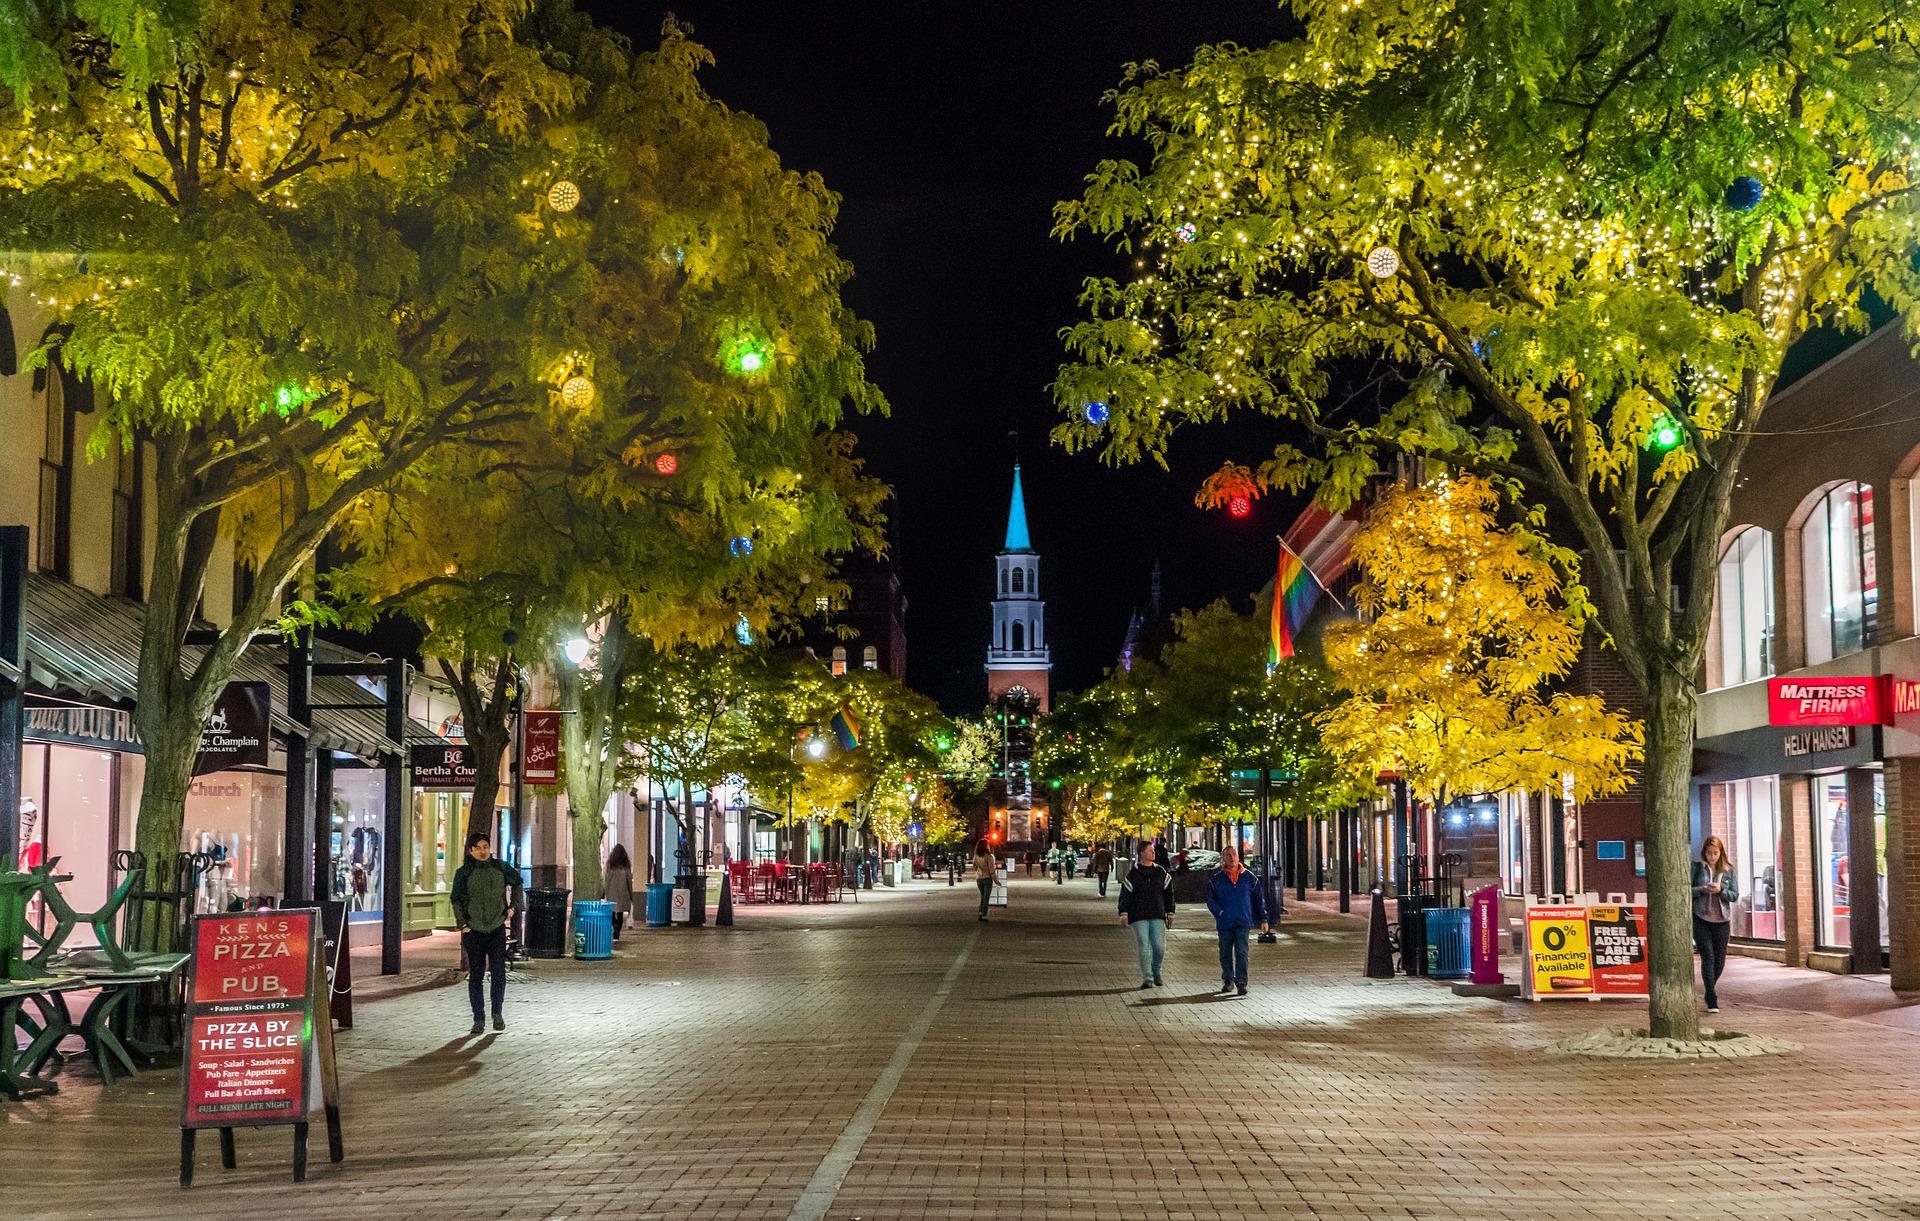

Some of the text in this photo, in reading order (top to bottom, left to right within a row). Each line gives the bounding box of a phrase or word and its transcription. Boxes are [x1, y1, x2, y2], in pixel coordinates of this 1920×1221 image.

[1780, 685, 1867, 699] MATTRESS
[1800, 699, 1848, 714] FIRM
[212, 736, 259, 748] Champlain
[1784, 725, 1850, 757] HELLY HANSEN
[532, 743, 546, 754] ski
[527, 750, 556, 763] LOCAL
[415, 766, 451, 775] Bertha
[219, 921, 289, 934] KEN'S
[1594, 926, 1627, 936] FREE
[1594, 936, 1647, 946] ADJUST
[213, 941, 291, 961] PIZZA
[1535, 952, 1587, 962] Financing
[1596, 955, 1631, 965] BASE
[240, 963, 264, 974] AND
[1537, 962, 1585, 972] Available
[222, 975, 279, 994] PUB
[214, 1004, 243, 1012] Famous
[244, 1003, 265, 1011] Since
[207, 1020, 290, 1035] PIZZA BY
[198, 1035, 298, 1051] THE SLICE
[198, 1058, 295, 1070] Soup Salad Sandwiches
[206, 1068, 287, 1078] Pub Fare Appetizers
[218, 1078, 274, 1088] Italian Dinners
[204, 1090, 220, 1098] Full
[221, 1089, 235, 1097] Bar
[243, 1088, 263, 1096] Craft
[264, 1087, 286, 1095] Beers
[199, 1101, 291, 1113] FULL MENU LATE NIGHT
